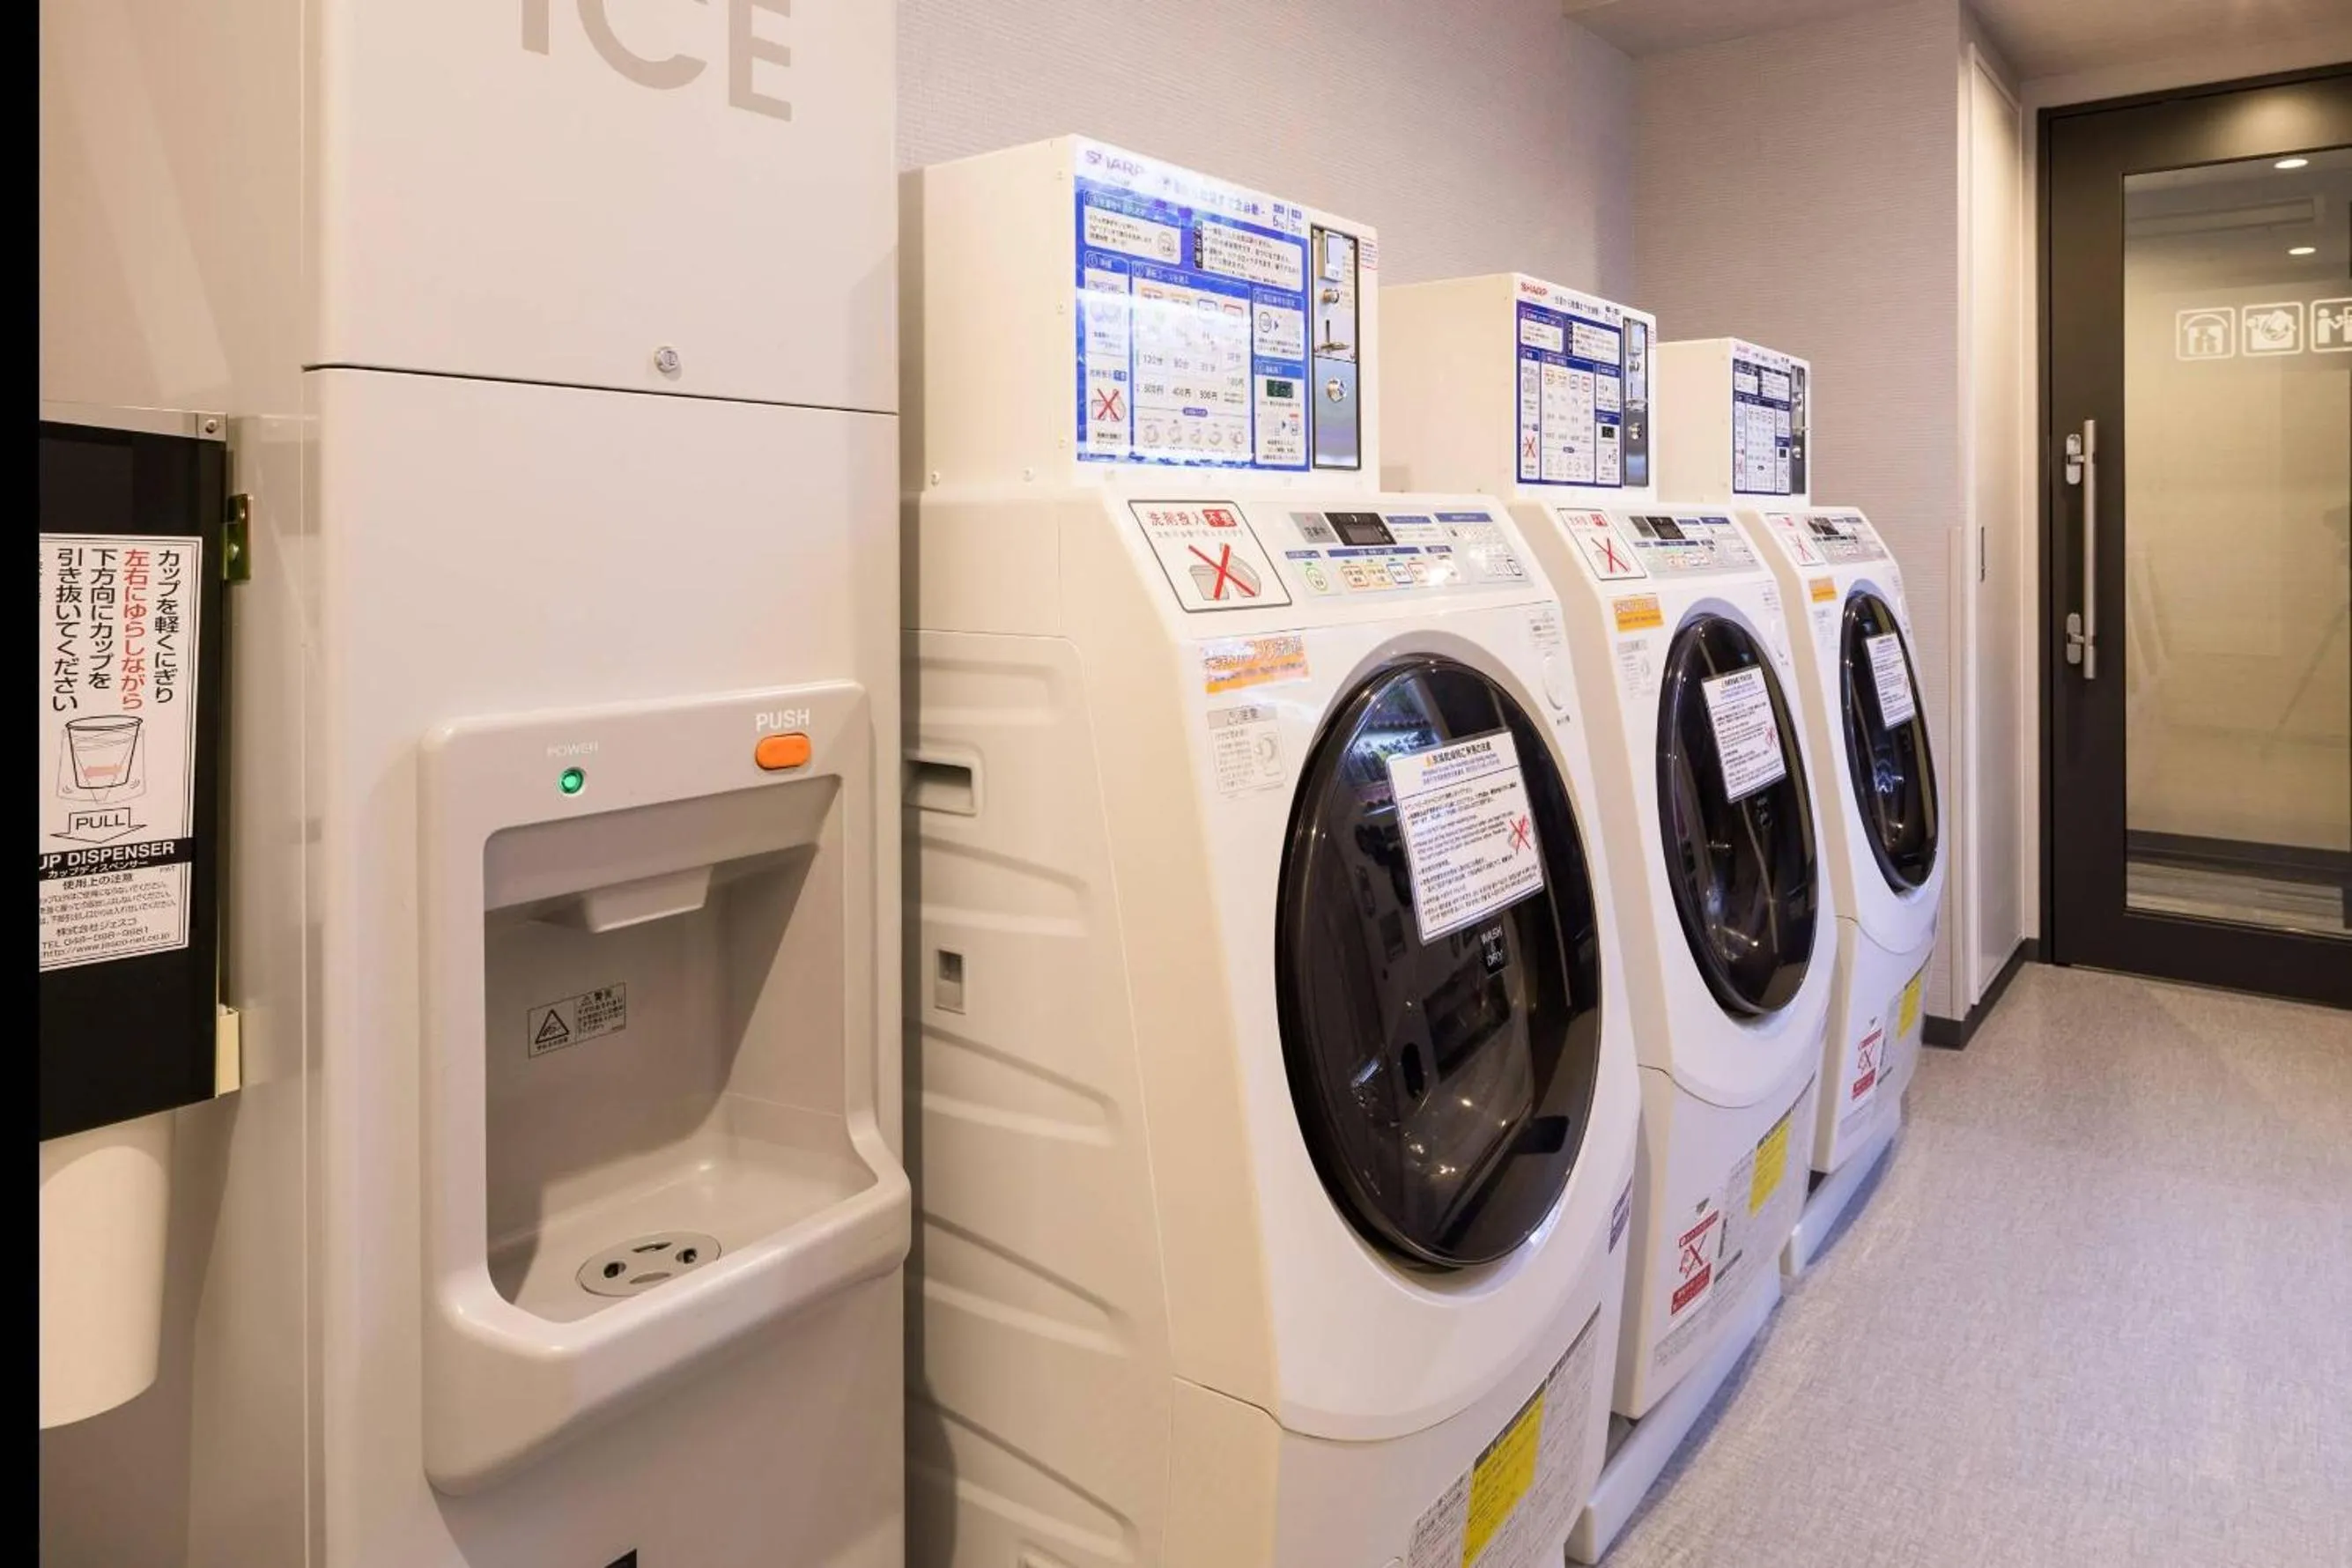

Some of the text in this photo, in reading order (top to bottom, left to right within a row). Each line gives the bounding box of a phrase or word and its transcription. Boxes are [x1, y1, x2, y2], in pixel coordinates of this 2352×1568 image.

[88, 547, 118, 689] 下方向にカップを
[154, 550, 181, 704] カップを軽くにぎり
[53, 547, 83, 712] 引き抜いてください
[121, 548, 151, 711] 左右にゆらしながら
[755, 708, 810, 733] PUSH
[547, 741, 599, 758] POWER
[76, 814, 126, 831] PULL
[67, 841, 175, 867] DISPENSER
[48, 860, 149, 879] カップディスペンサー
[63, 873, 134, 891] 使用上の注意
[42, 940, 60, 950] TEL
[1487, 949, 1503, 966] DRY
